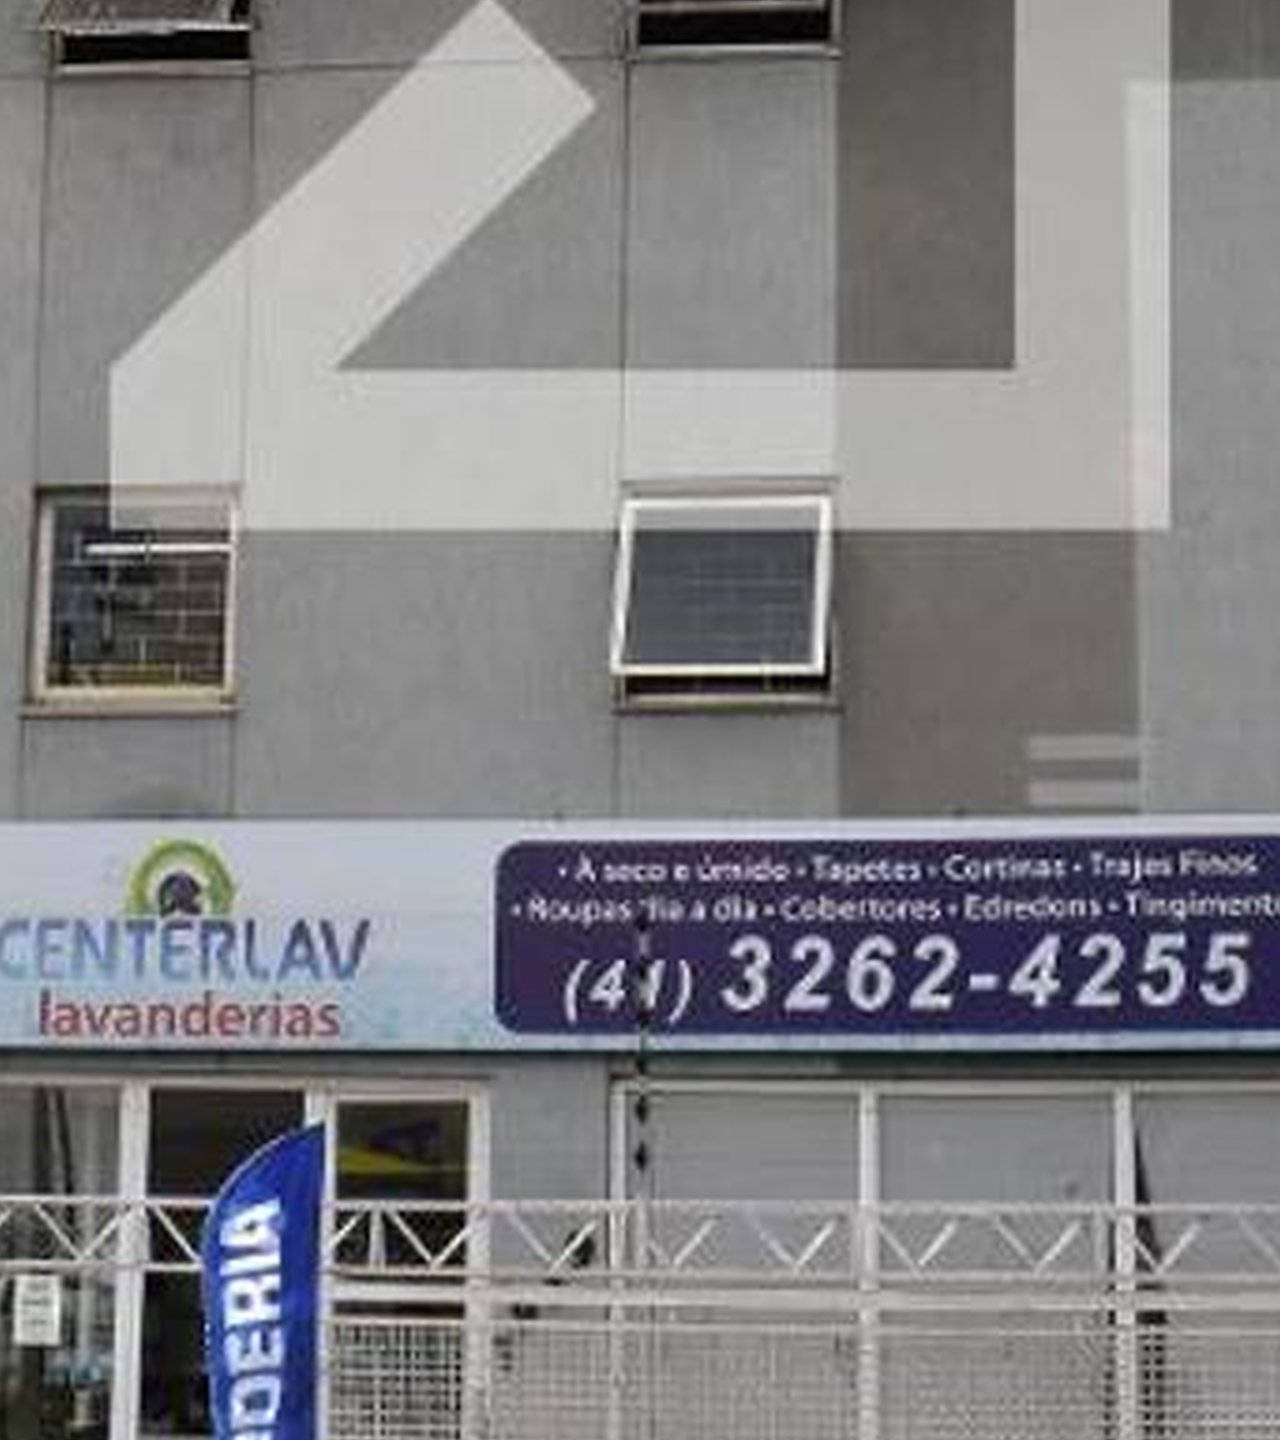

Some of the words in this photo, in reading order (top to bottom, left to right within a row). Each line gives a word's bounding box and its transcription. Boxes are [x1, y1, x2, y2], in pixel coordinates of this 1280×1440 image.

[812, 854, 922, 885] Tapetes
[528, 897, 632, 930] Roupas
[780, 894, 943, 923] Cobertores
[564, 958, 693, 1024] (41)
[720, 933, 1253, 1013] 3262-4255
[38, 990, 341, 1038] lavanderias
